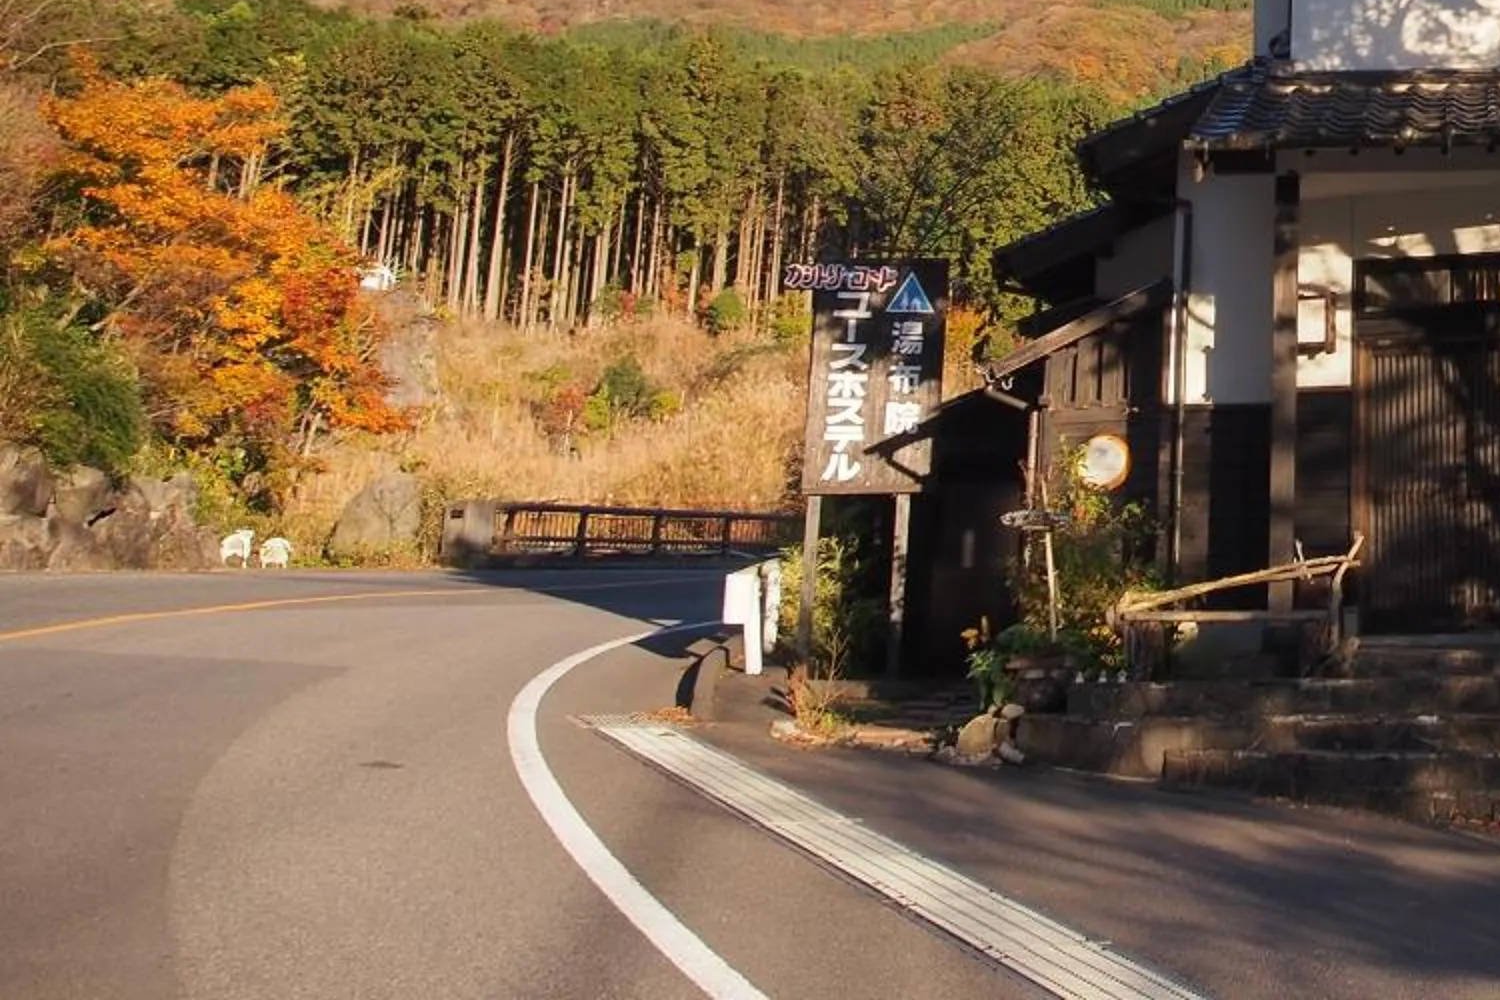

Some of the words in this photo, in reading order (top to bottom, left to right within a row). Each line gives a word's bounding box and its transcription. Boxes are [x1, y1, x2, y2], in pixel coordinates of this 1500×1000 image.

[821, 292, 873, 482] ユースホステル
[883, 321, 923, 436] 湯布院
